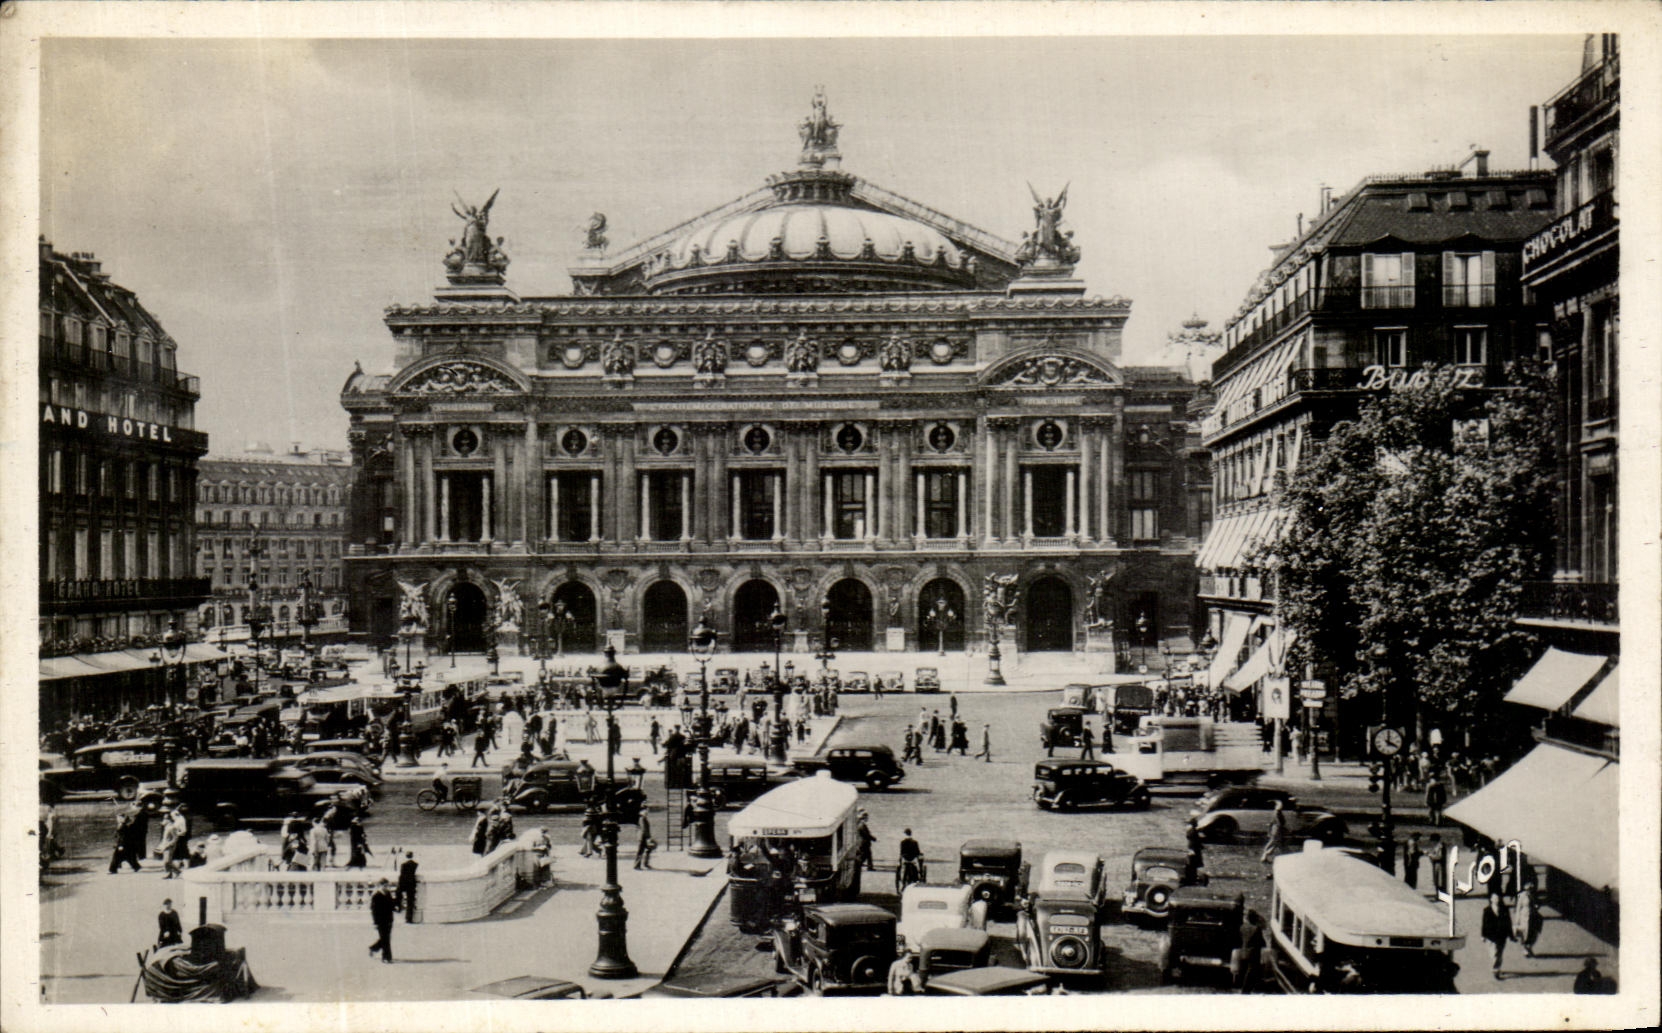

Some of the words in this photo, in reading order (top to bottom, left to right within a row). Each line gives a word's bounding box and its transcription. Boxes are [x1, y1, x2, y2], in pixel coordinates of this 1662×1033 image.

[1522, 204, 1596, 264] CHOCOLAT
[43, 404, 88, 429] AND
[107, 416, 172, 443] HOTEL
[105, 580, 141, 597] HOTEL
